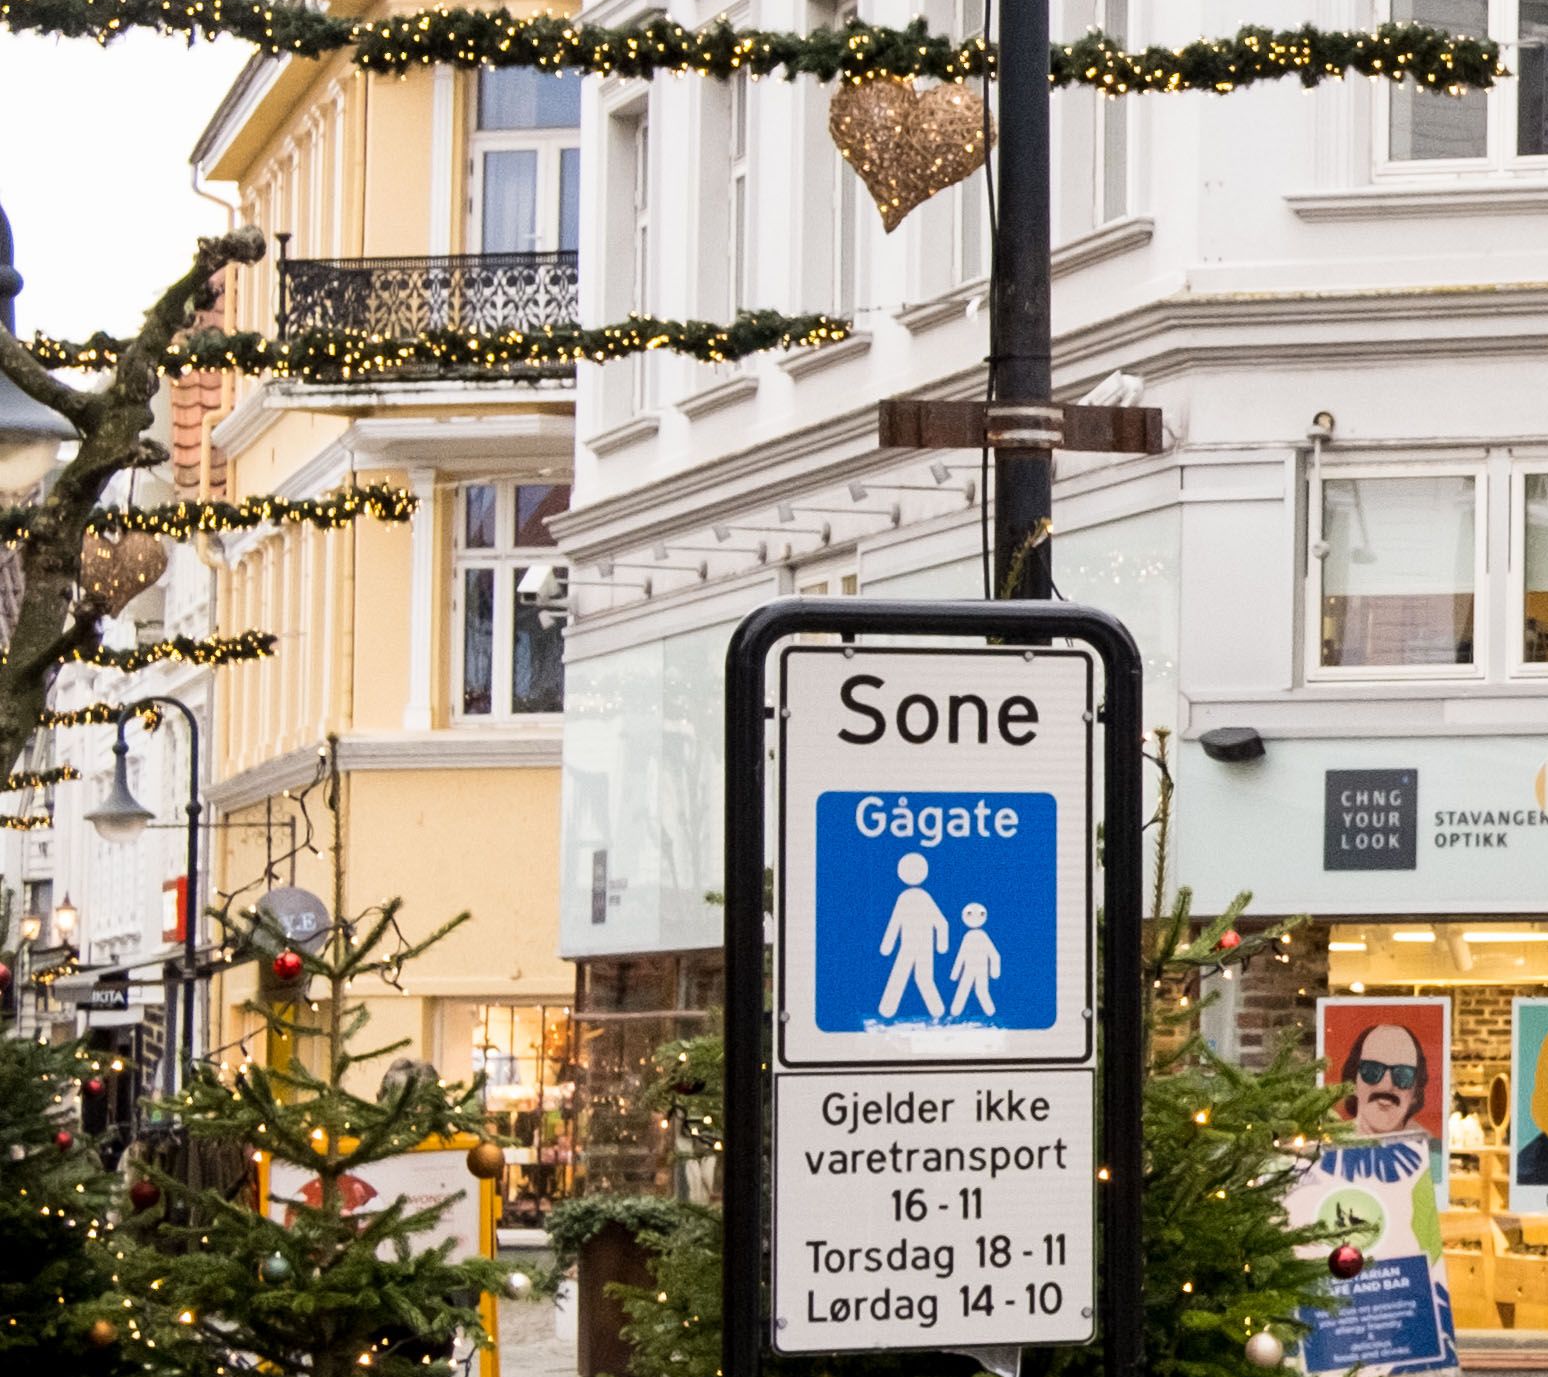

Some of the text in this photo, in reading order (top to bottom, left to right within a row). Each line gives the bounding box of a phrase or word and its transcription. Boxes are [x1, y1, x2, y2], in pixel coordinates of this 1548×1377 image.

[838, 674, 1039, 745] Sone
[1340, 789, 1403, 807] CHNG
[855, 796, 1020, 848] Gågate
[1342, 812, 1401, 828] YOUR
[1340, 833, 1401, 850] LOOK
[1434, 832, 1508, 849] OPTIKK
[821, 1089, 1051, 1134] Gjelder ikke
[805, 1135, 1068, 1177] varetransport
[891, 1188, 928, 1223] 16
[959, 1187, 984, 1221] 11
[806, 1239, 956, 1281] Torsdag
[975, 1236, 1012, 1269] 18
[1043, 1234, 1067, 1267] 11
[1353, 1281, 1381, 1293] AND
[1383, 1277, 1410, 1290] BAR
[807, 1287, 938, 1328] Lørdag
[959, 1284, 995, 1317] 14
[1025, 1282, 1063, 1316] 10
